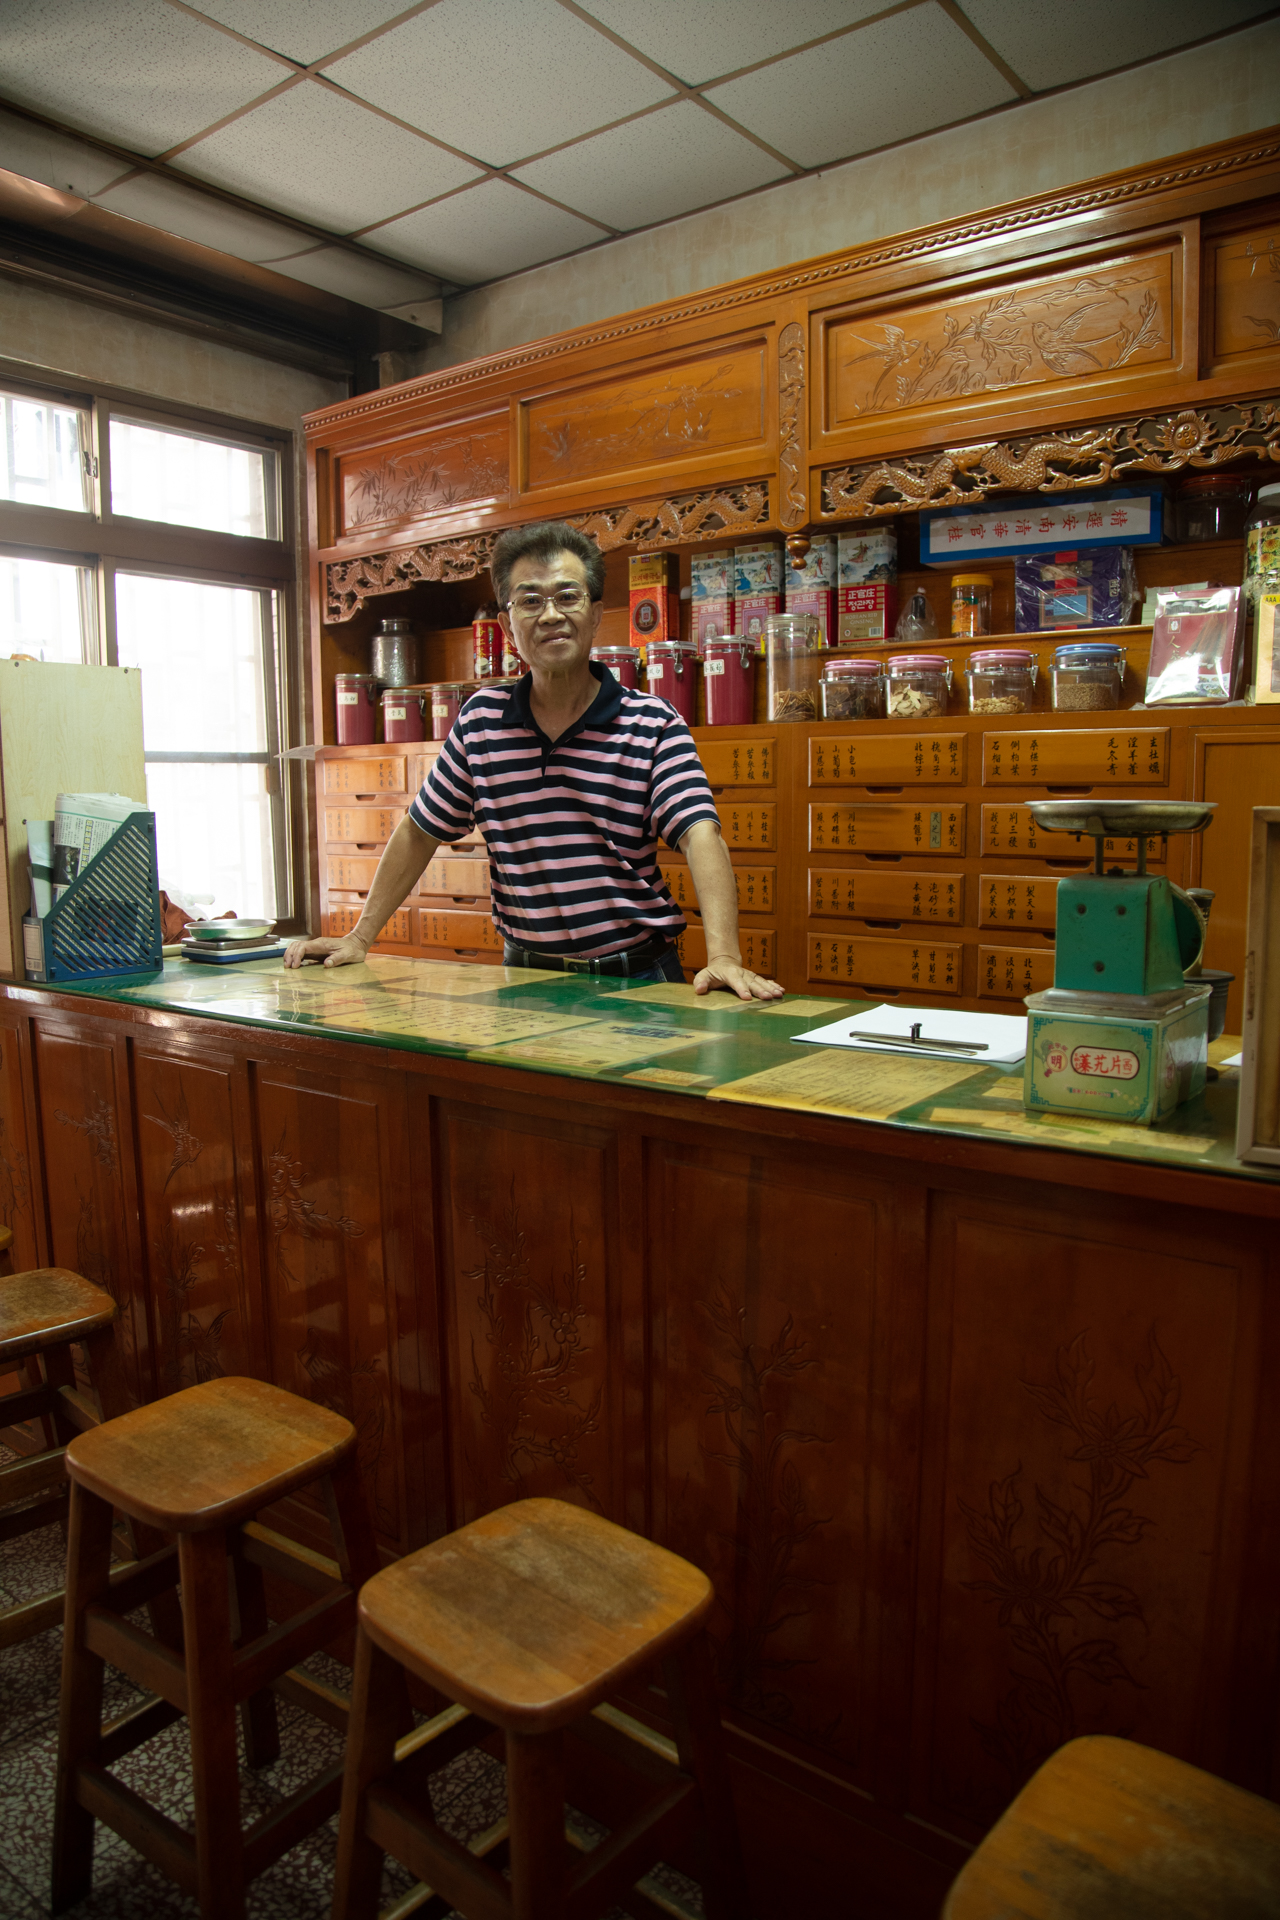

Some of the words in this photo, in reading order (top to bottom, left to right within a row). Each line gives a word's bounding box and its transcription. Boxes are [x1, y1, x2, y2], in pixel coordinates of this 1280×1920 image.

[948, 509, 1128, 543] 精選安南清華官桂
[794, 593, 817, 603] 正官庄
[848, 588, 875, 600] 正官庄
[700, 604, 722, 613] 正官庄
[744, 598, 766, 608] 正官庄
[848, 600, 874, 611] 정관장
[1106, 737, 1118, 776] 毛冬青
[830, 943, 839, 975] 石決明
[1023, 958, 1032, 993] 北五味
[1051, 1055, 1062, 1069] 明
